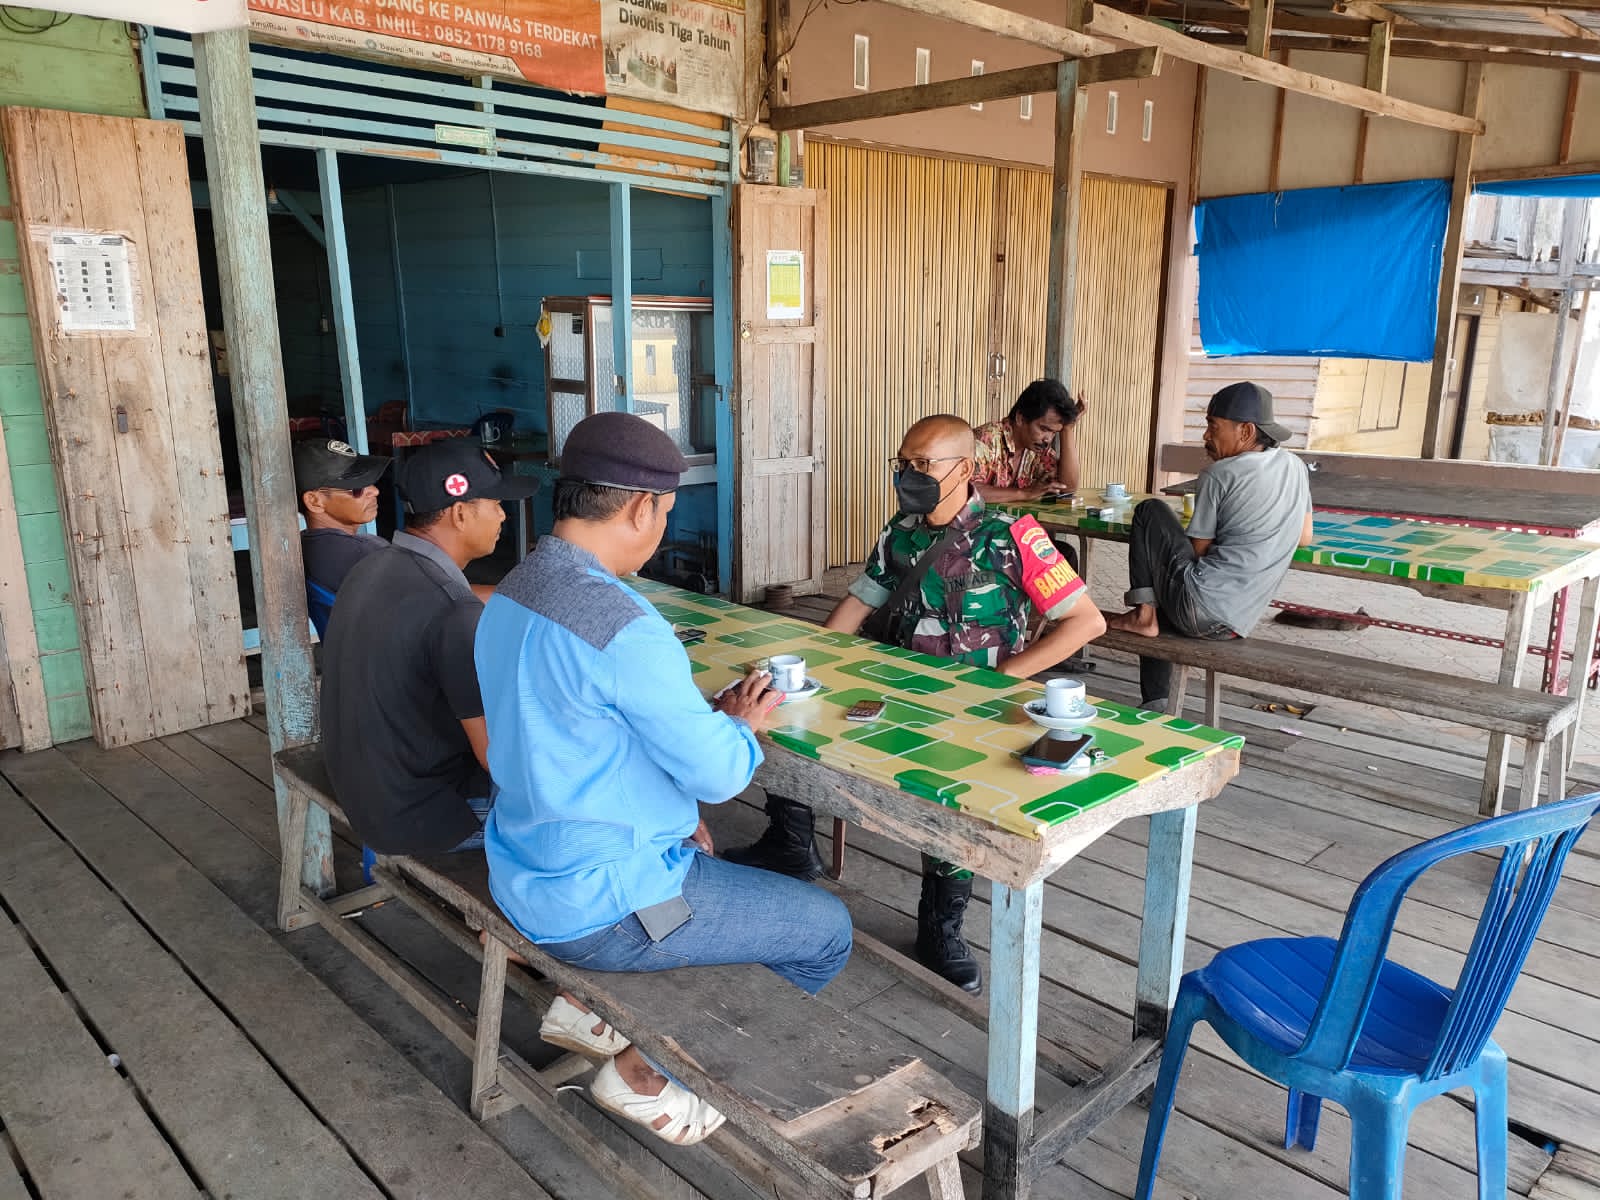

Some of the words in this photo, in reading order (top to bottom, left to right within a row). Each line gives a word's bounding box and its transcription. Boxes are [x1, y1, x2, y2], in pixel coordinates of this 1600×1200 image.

[249, 0, 324, 17] WASLU
[329, 4, 371, 26] KAB.
[376, 13, 421, 36] INHIL
[434, 25, 473, 46] 0852
[475, 33, 506, 51] 1178
[509, 39, 543, 58] 9168
[429, 1, 450, 20] KE
[454, 7, 522, 34] PANWAS
[525, 20, 598, 49] TERDEKAT
[619, 7, 665, 34] Divonis
[669, 20, 693, 43] Tiga
[696, 29, 731, 52] Tahun
